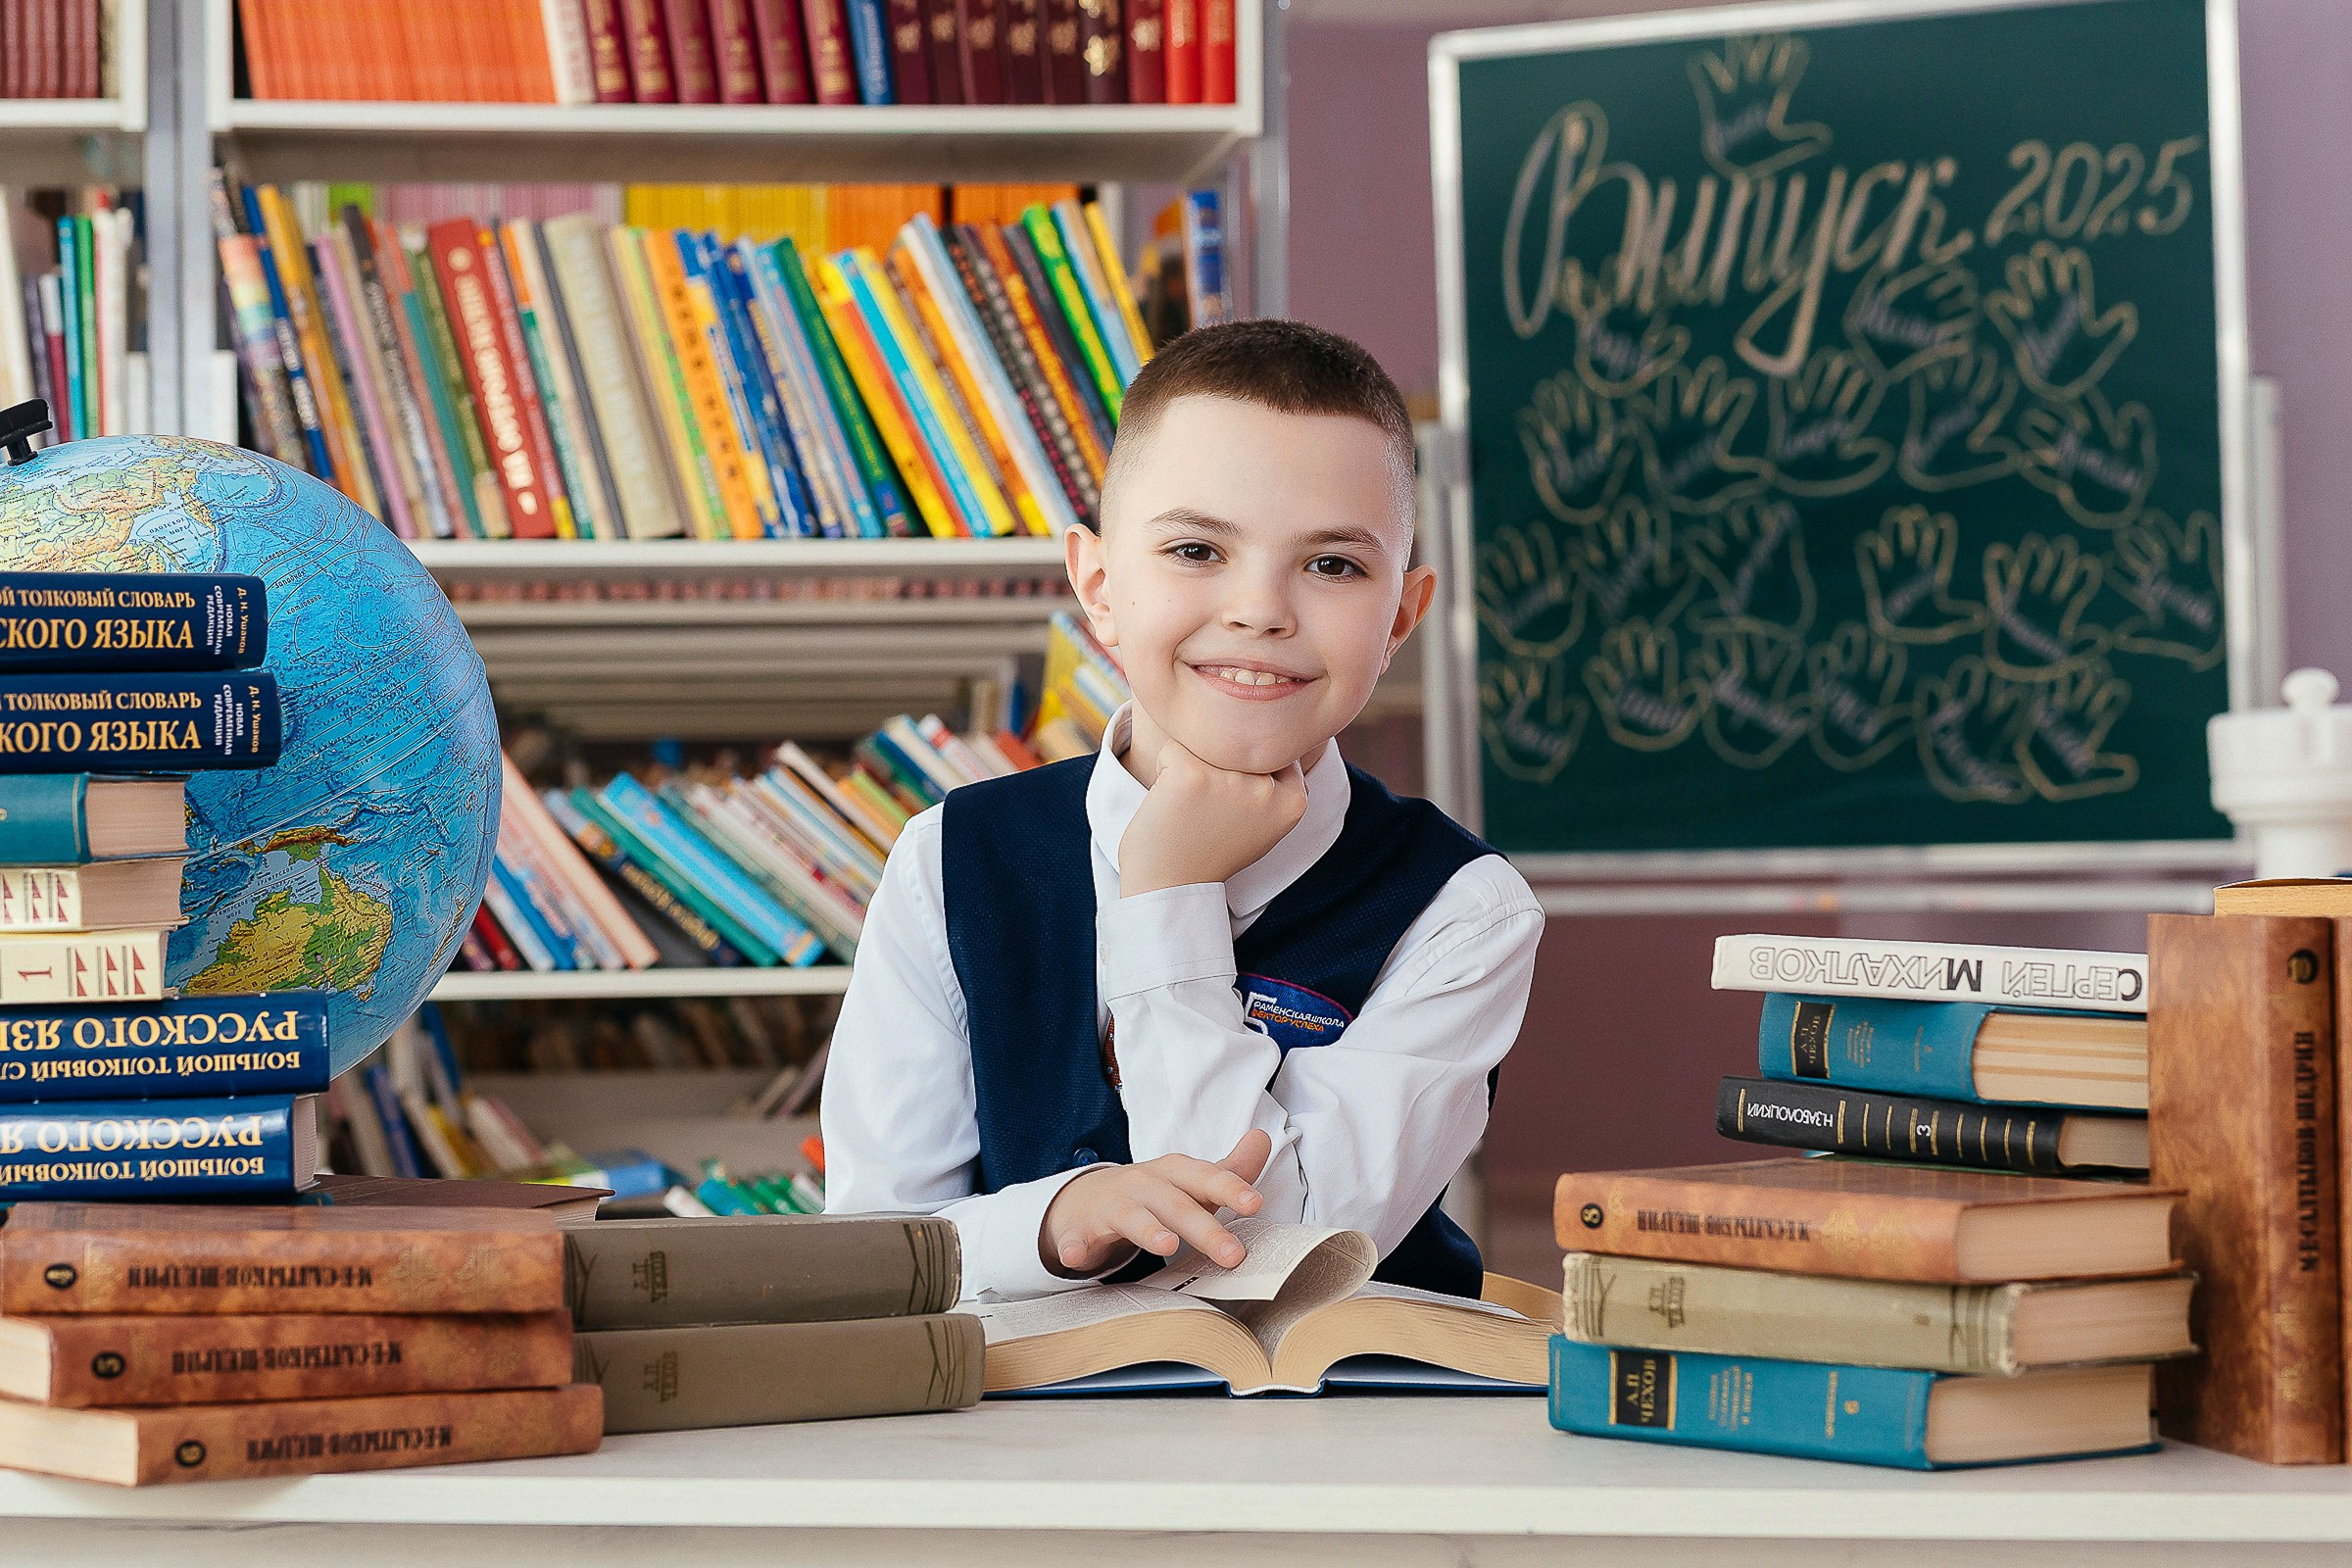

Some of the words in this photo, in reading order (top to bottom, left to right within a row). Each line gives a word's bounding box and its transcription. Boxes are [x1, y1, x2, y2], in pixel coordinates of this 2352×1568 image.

[1985, 135, 2201, 240] 2025
[17, 587, 115, 608] ТОЛКОВЫЙ
[119, 591, 196, 609] СЛОВАРЬ
[237, 587, 247, 603] Д.
[206, 595, 215, 647] РЕДАКЦИЯ
[214, 585, 225, 656] СОВРЕМЕННАЯ
[239, 604, 247, 616] Н.
[93, 618, 195, 650] ЯЗЫКА
[238, 615, 249, 655] Ушаков
[3, 690, 113, 710] ТОЛКОВЫЙ
[116, 692, 202, 710] СЛОВАРЬ
[248, 686, 259, 701] Д.
[251, 701, 261, 712] Н.
[214, 694, 223, 746] РЕДАКЦИЯ
[222, 684, 233, 756] СОВРЕМЕННАЯ
[235, 703, 244, 737] НОВАЯ
[251, 713, 261, 754] Ушаков
[87, 720, 202, 752] ЯЗЫКА
[18, 966, 53, 981] 1
[1749, 947, 1983, 991] МИХАЛКОВ
[2003, 961, 2142, 1001] СЕРГЕЙ
[73, 1010, 299, 1049] РУССКОГО
[1251, 1009, 1289, 1023] ВЕКТОР
[1290, 1018, 1324, 1032] УСПЕХА
[1310, 1015, 1345, 1028] ШКОЛА
[30, 1056, 172, 1083] ТОЛКОВЫЙ
[176, 1052, 300, 1077] БОЛЬШОЙ
[1747, 1102, 1834, 1128] Н.ЗАБОЛОЦКИЙ
[37, 1116, 263, 1152] РУССКОГО
[1916, 1123, 1932, 1137] 3
[0, 1161, 134, 1186] ТОЛКОВЫЙ
[140, 1156, 265, 1181] БОЛЬШОЙ
[1587, 1206, 1600, 1225] 8
[1641, 1358, 1657, 1424] ЧЕХОВ
